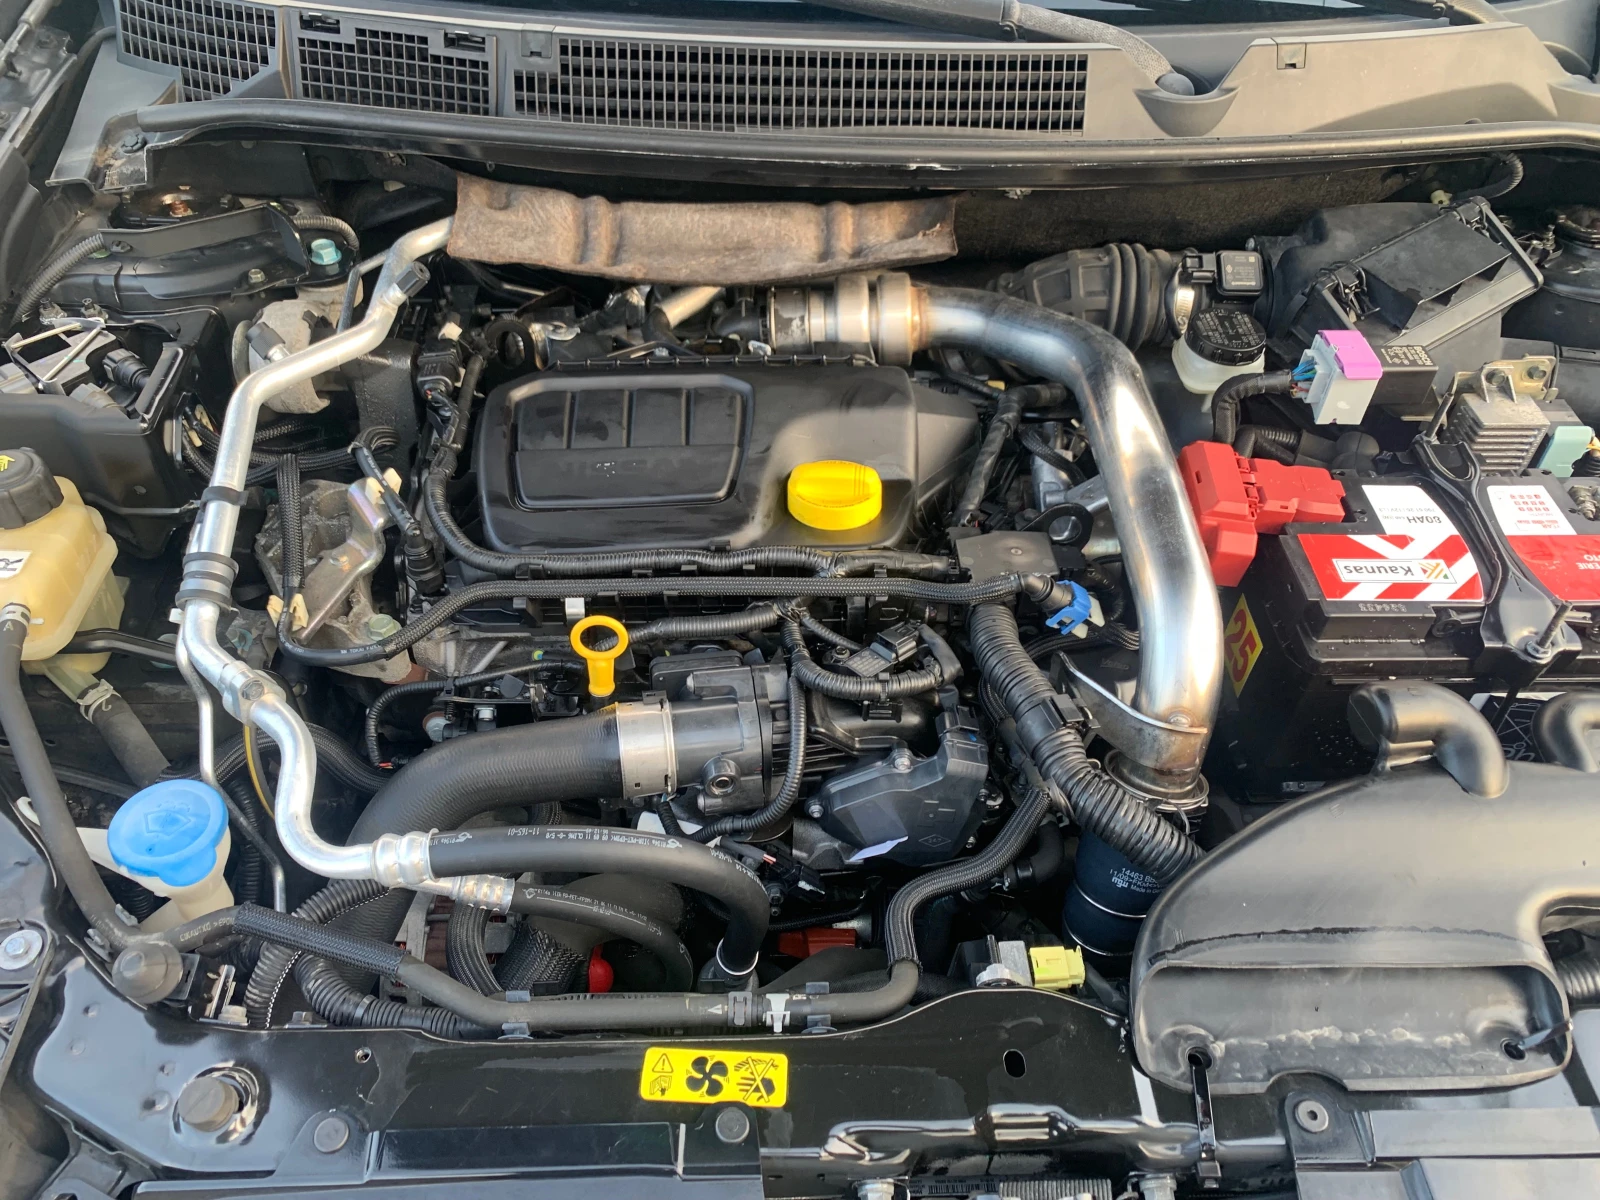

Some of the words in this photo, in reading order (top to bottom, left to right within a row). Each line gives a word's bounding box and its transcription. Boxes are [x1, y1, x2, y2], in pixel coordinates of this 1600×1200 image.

[1414, 346, 1433, 365] BOSCH
[1343, 565, 1414, 576] Kaunas
[1224, 609, 1257, 682] 25
[1121, 867, 1144, 881] 14463
